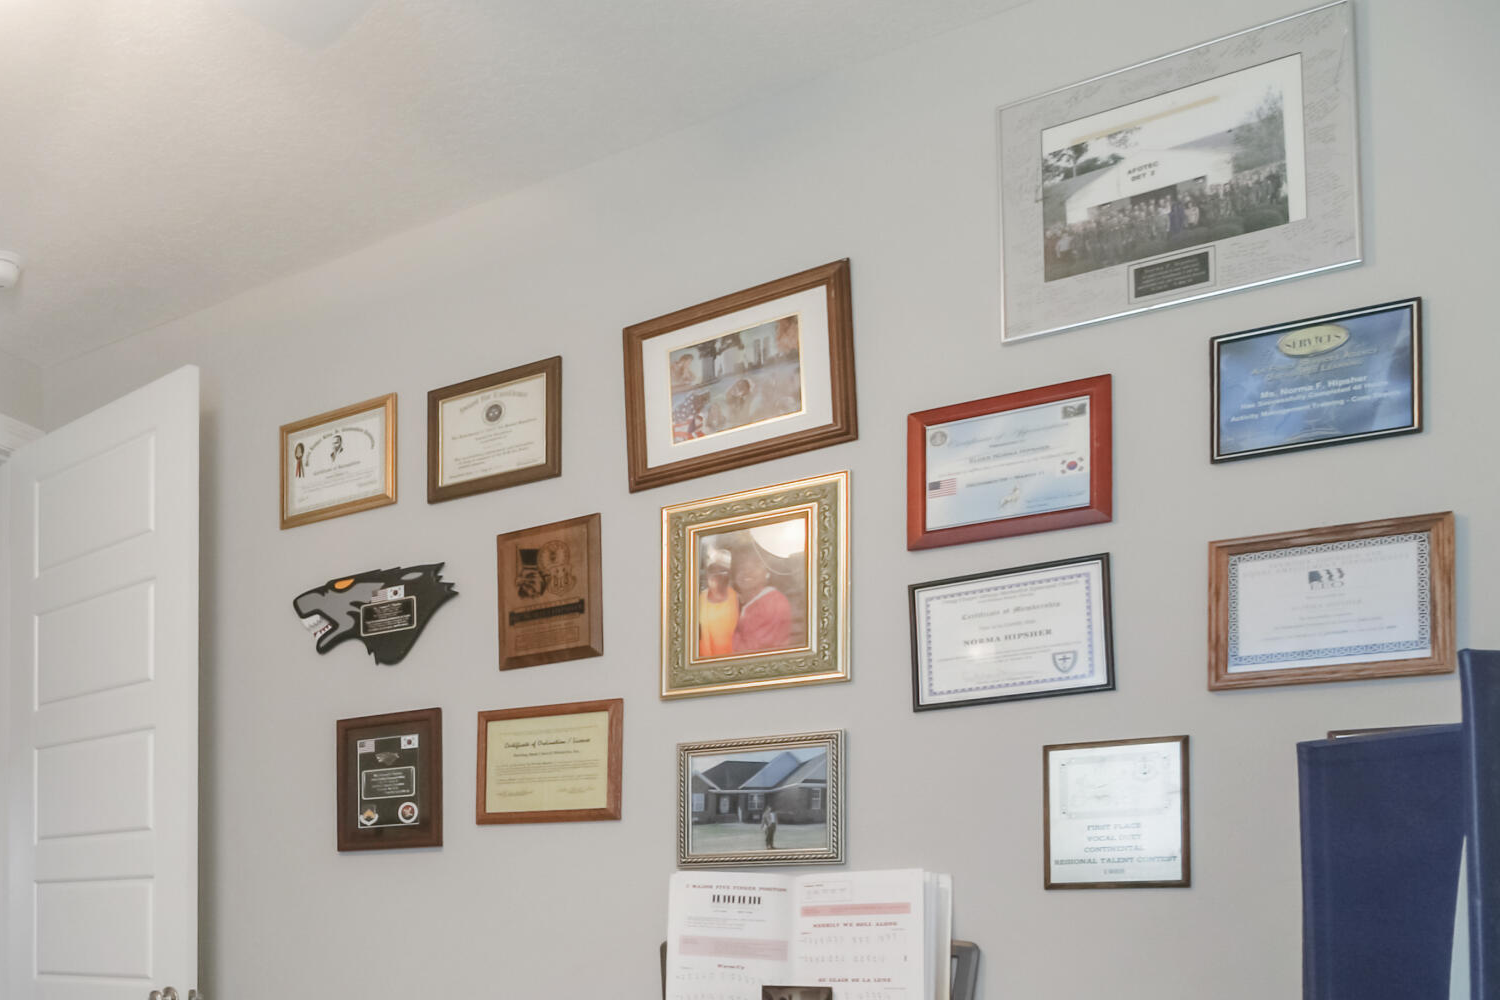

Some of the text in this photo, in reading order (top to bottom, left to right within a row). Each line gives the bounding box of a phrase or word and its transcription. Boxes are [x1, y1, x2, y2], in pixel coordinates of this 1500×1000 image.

[1280, 384, 1314, 397] Norma
[963, 629, 1053, 648] NORMA HIPSHER
